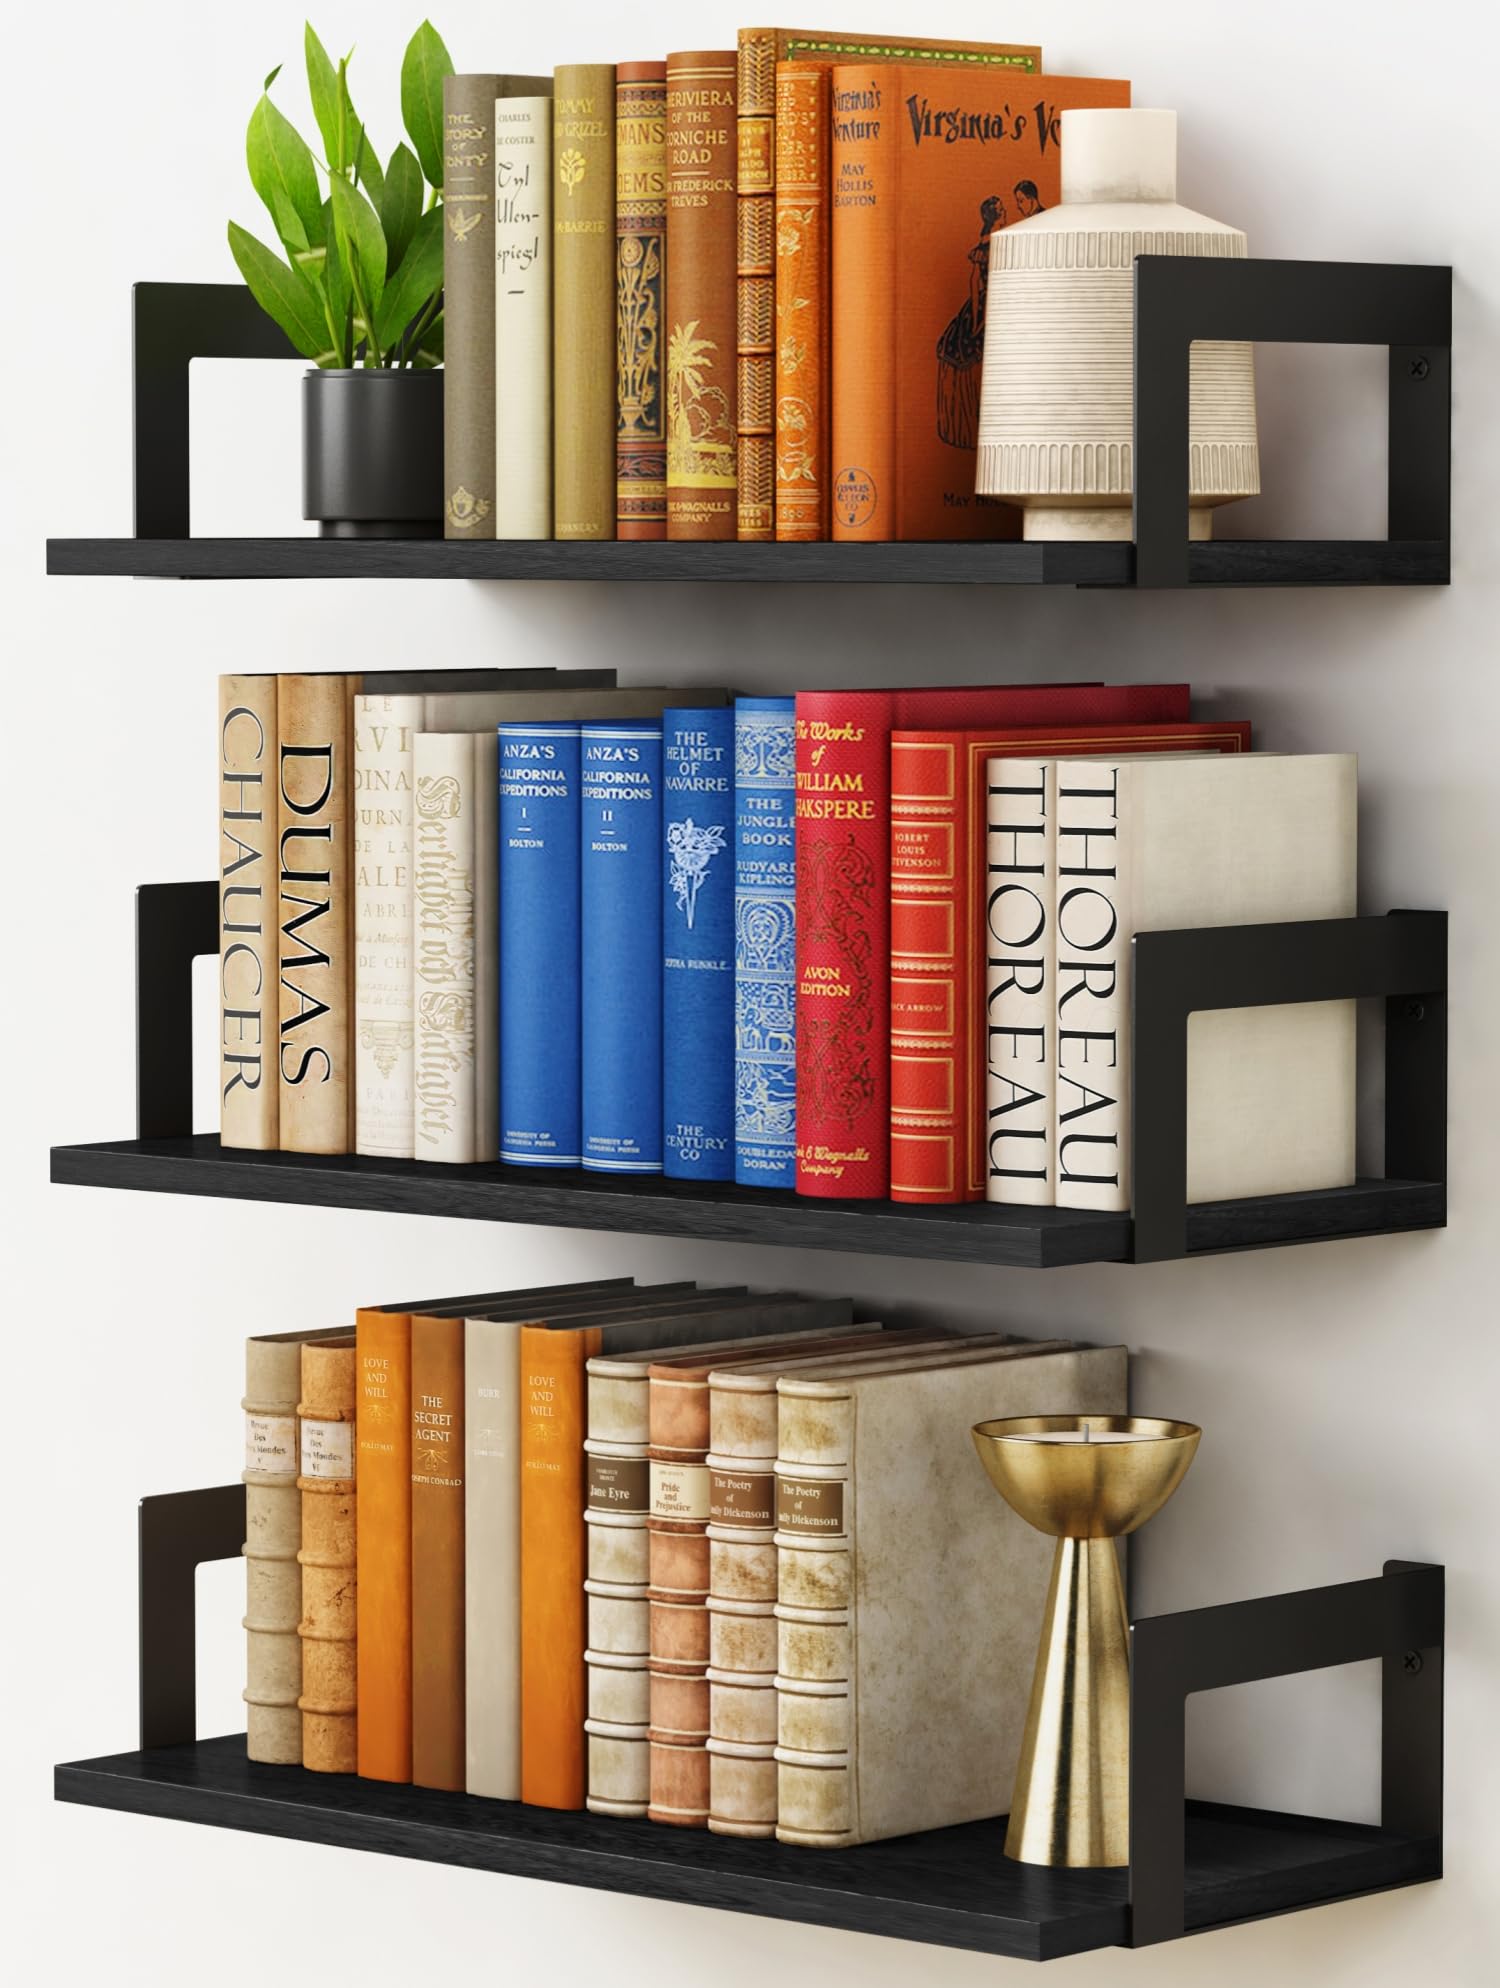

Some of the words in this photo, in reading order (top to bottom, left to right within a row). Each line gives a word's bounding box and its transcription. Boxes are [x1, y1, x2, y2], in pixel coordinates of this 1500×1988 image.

[686, 111, 712, 123] THE
[906, 93, 1028, 148] Virginia's
[1033, 100, 1061, 156] Ve
[446, 127, 487, 140] TORY
[617, 122, 666, 146] MANS
[673, 148, 713, 164] ROAD
[841, 163, 865, 177] MAY
[617, 172, 665, 194] OEMS
[836, 179, 873, 193] HOLLIS
[834, 195, 876, 209] BARTON
[809, 721, 865, 741] Works
[674, 731, 708, 746] THE
[504, 744, 556, 760] ANZA'S
[586, 746, 640, 762] ANZA'S
[666, 746, 724, 761] HELMET
[811, 744, 827, 767] of
[500, 768, 566, 782] CALIFORNIA
[679, 762, 701, 776] OF
[582, 771, 650, 784] CALIFORNIA
[665, 776, 729, 792] NAVARRE
[745, 798, 783, 810] THE
[796, 798, 876, 819] HAKSPERE
[737, 816, 796, 829] JUNGLE
[509, 838, 544, 849] BOLTON
[591, 841, 628, 852] BOLTON
[742, 833, 792, 847] BOOK
[896, 845, 926, 855] LOUIS
[358, 865, 407, 888] ALE
[739, 873, 795, 885] KIPLING
[222, 705, 264, 1110] CHAUCER
[279, 741, 333, 1085] DUMAS
[359, 955, 377, 969] DE
[384, 955, 407, 969] CH
[804, 966, 841, 980] AVON
[987, 765, 1048, 1184] THOREAU
[1057, 767, 1119, 1189] THOREAU
[907, 1003, 944, 1012] ARROW
[676, 1124, 704, 1137] THE
[666, 1134, 728, 1150] CENTURY
[679, 1149, 700, 1162] CO
[743, 1158, 787, 1171] DORAN
[363, 1357, 389, 1370] LOVE
[366, 1373, 387, 1384] AND
[528, 1375, 556, 1388] LOVE
[364, 1386, 389, 1398] WILL
[531, 1391, 553, 1402] AND
[420, 1395, 443, 1408] THE
[529, 1405, 555, 1417] WILL
[414, 1411, 453, 1426] SECRET
[415, 1429, 451, 1443] AGENT
[430, 1475, 463, 1487] CONRAD
[661, 1482, 680, 1493] Pride
[714, 1477, 727, 1488] The
[727, 1479, 752, 1492] Poetry
[590, 1484, 607, 1497] Jane
[608, 1487, 630, 1501] Eyre
[663, 1493, 678, 1502] and
[725, 1493, 735, 1503] of
[783, 1484, 795, 1496] The
[796, 1487, 821, 1500] Poetry
[794, 1501, 803, 1511] of
